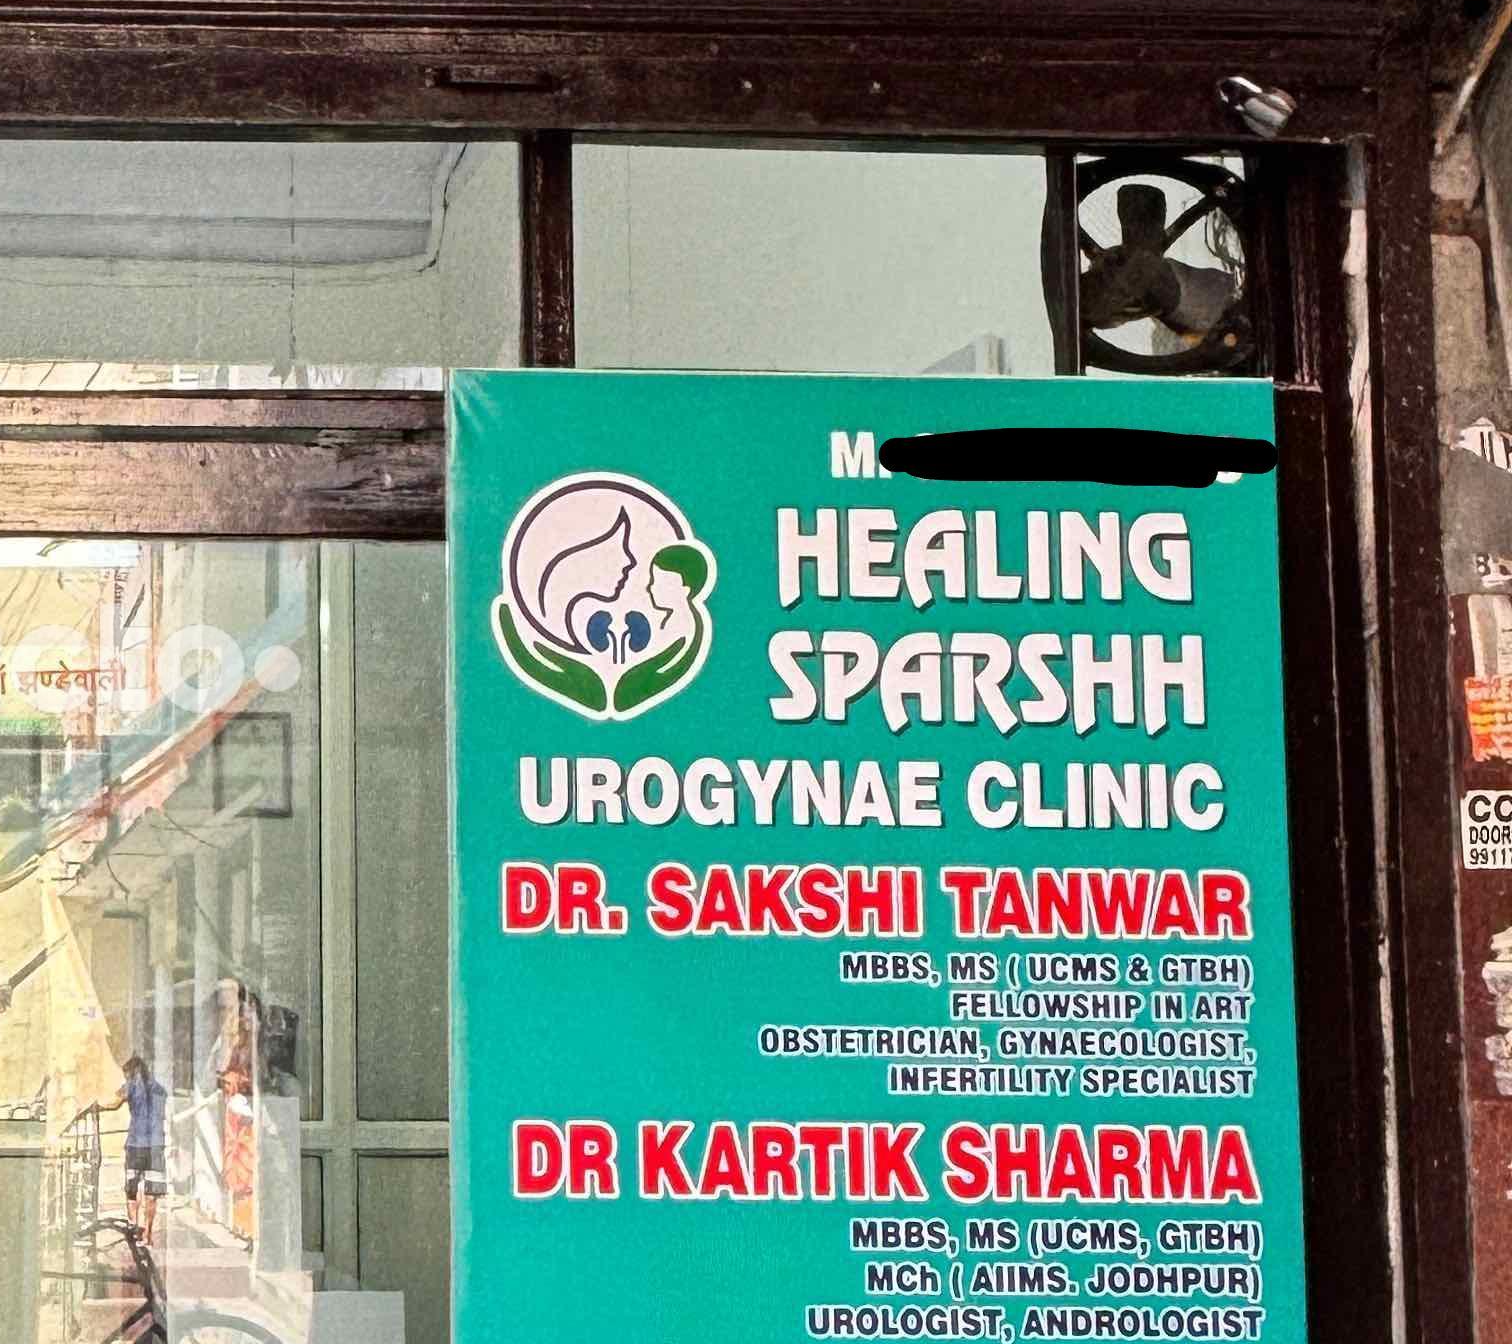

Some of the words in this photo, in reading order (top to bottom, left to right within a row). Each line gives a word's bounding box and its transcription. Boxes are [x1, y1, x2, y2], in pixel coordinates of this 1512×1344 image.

[776, 507, 1192, 609] HEALING
[768, 630, 1206, 736] SPARSHH
[519, 756, 943, 827] UROGYNAE
[967, 760, 1224, 831] CLINIC
[500, 860, 629, 937] DR.
[645, 861, 925, 941] SAKSHI
[939, 865, 1255, 942] TANWAR
[841, 953, 940, 984] MBBS,
[949, 954, 997, 982] MS
[1127, 955, 1150, 983] &
[1161, 956, 1251, 990] GTBH)
[951, 988, 1143, 1020] FELLOWSHIP
[1153, 994, 1184, 1021] IN
[1194, 994, 1252, 1021] ART
[759, 1026, 989, 1061] OBSTETRICIAN,
[999, 1029, 1254, 1062] GYNAECOLOGIST,
[889, 1065, 1072, 1094] INFERTILITY
[1081, 1067, 1255, 1096] SPECIALIST
[510, 1118, 621, 1201] DR
[637, 1119, 930, 1203] KARTIK
[940, 1120, 1264, 1206] SHARMA
[851, 1220, 958, 1255] MBBS,
[967, 1220, 1018, 1251] MS
[1029, 1220, 1149, 1257] (UCMS,
[1158, 1221, 1261, 1258] GTBH)
[866, 1263, 940, 1293] MCh
[971, 1264, 1077, 1295] AIIMS.
[1086, 1265, 1261, 1301] JODHPUR)
[807, 1306, 1013, 1343] UROLOGIST,
[1022, 1308, 1262, 1339] ANDROLOGIST
